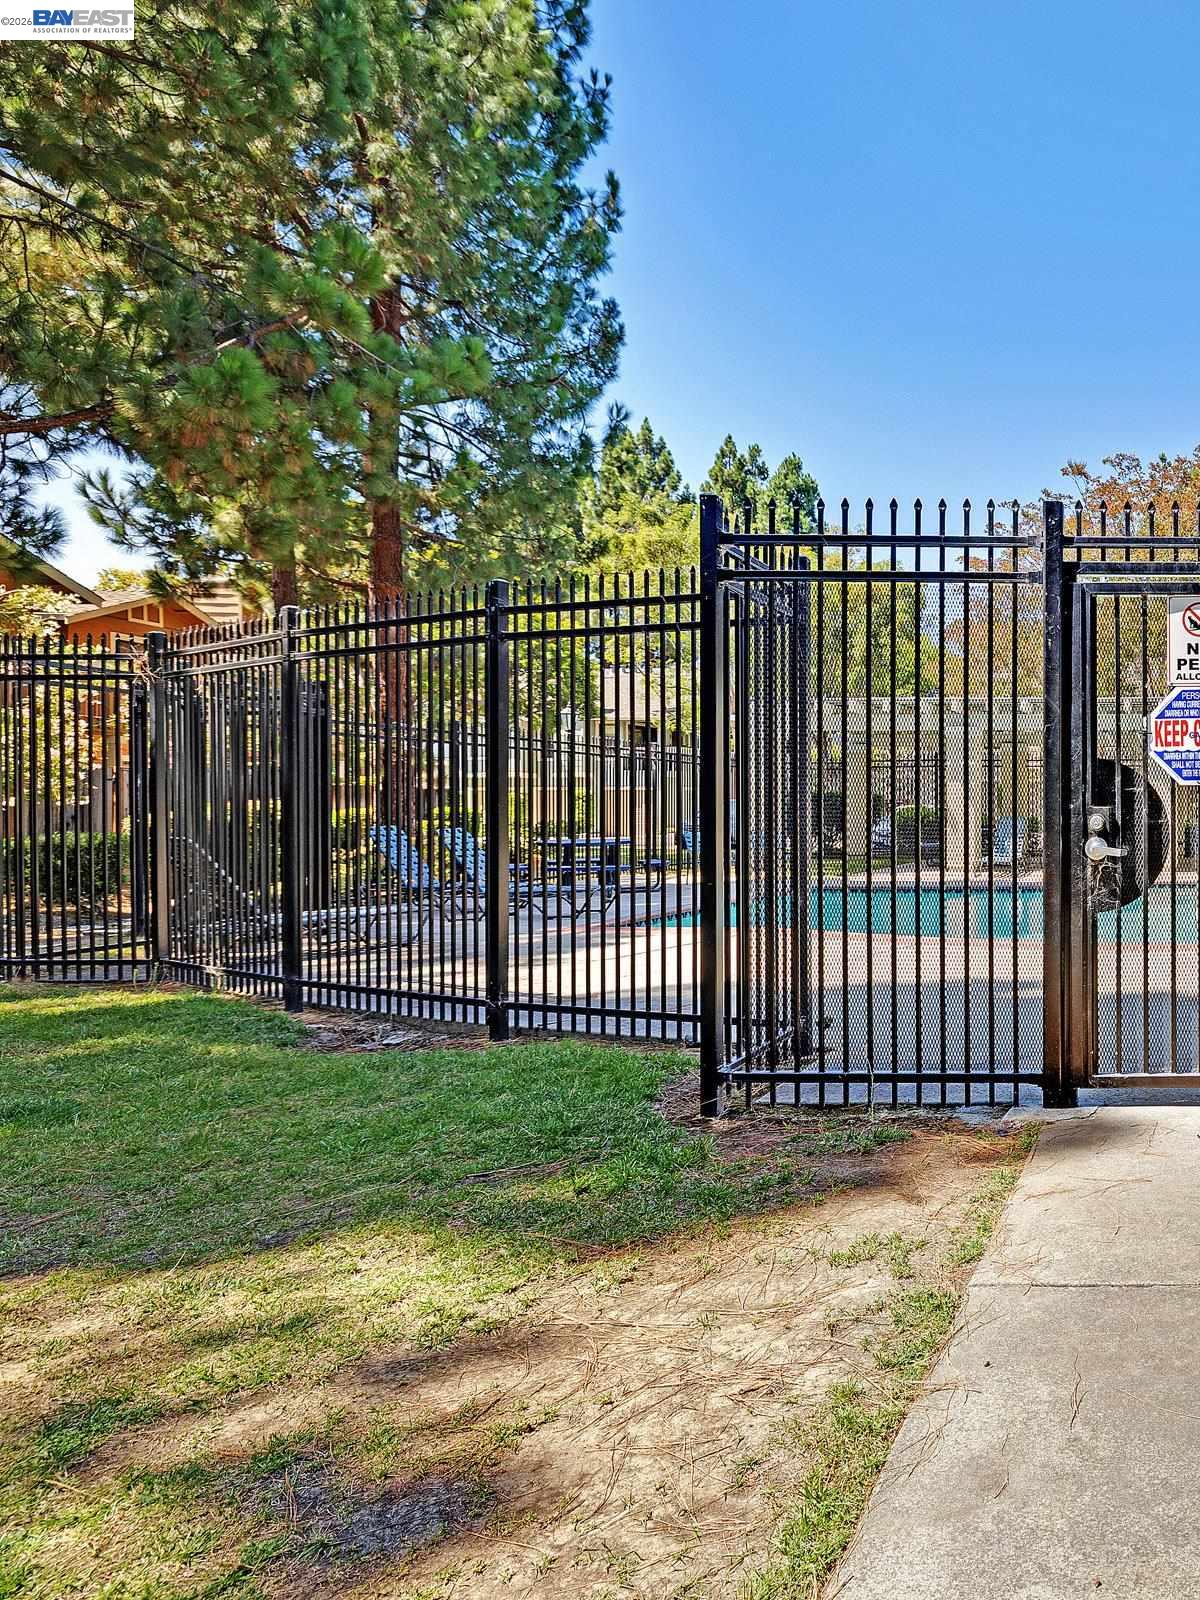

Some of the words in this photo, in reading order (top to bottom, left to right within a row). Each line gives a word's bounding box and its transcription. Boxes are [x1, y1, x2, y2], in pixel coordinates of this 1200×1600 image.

[1154, 719, 1188, 747] KEEP
[1171, 760, 1185, 768] SHALL
[1186, 760, 1194, 768] NOT
[1195, 760, 1200, 768] BE
